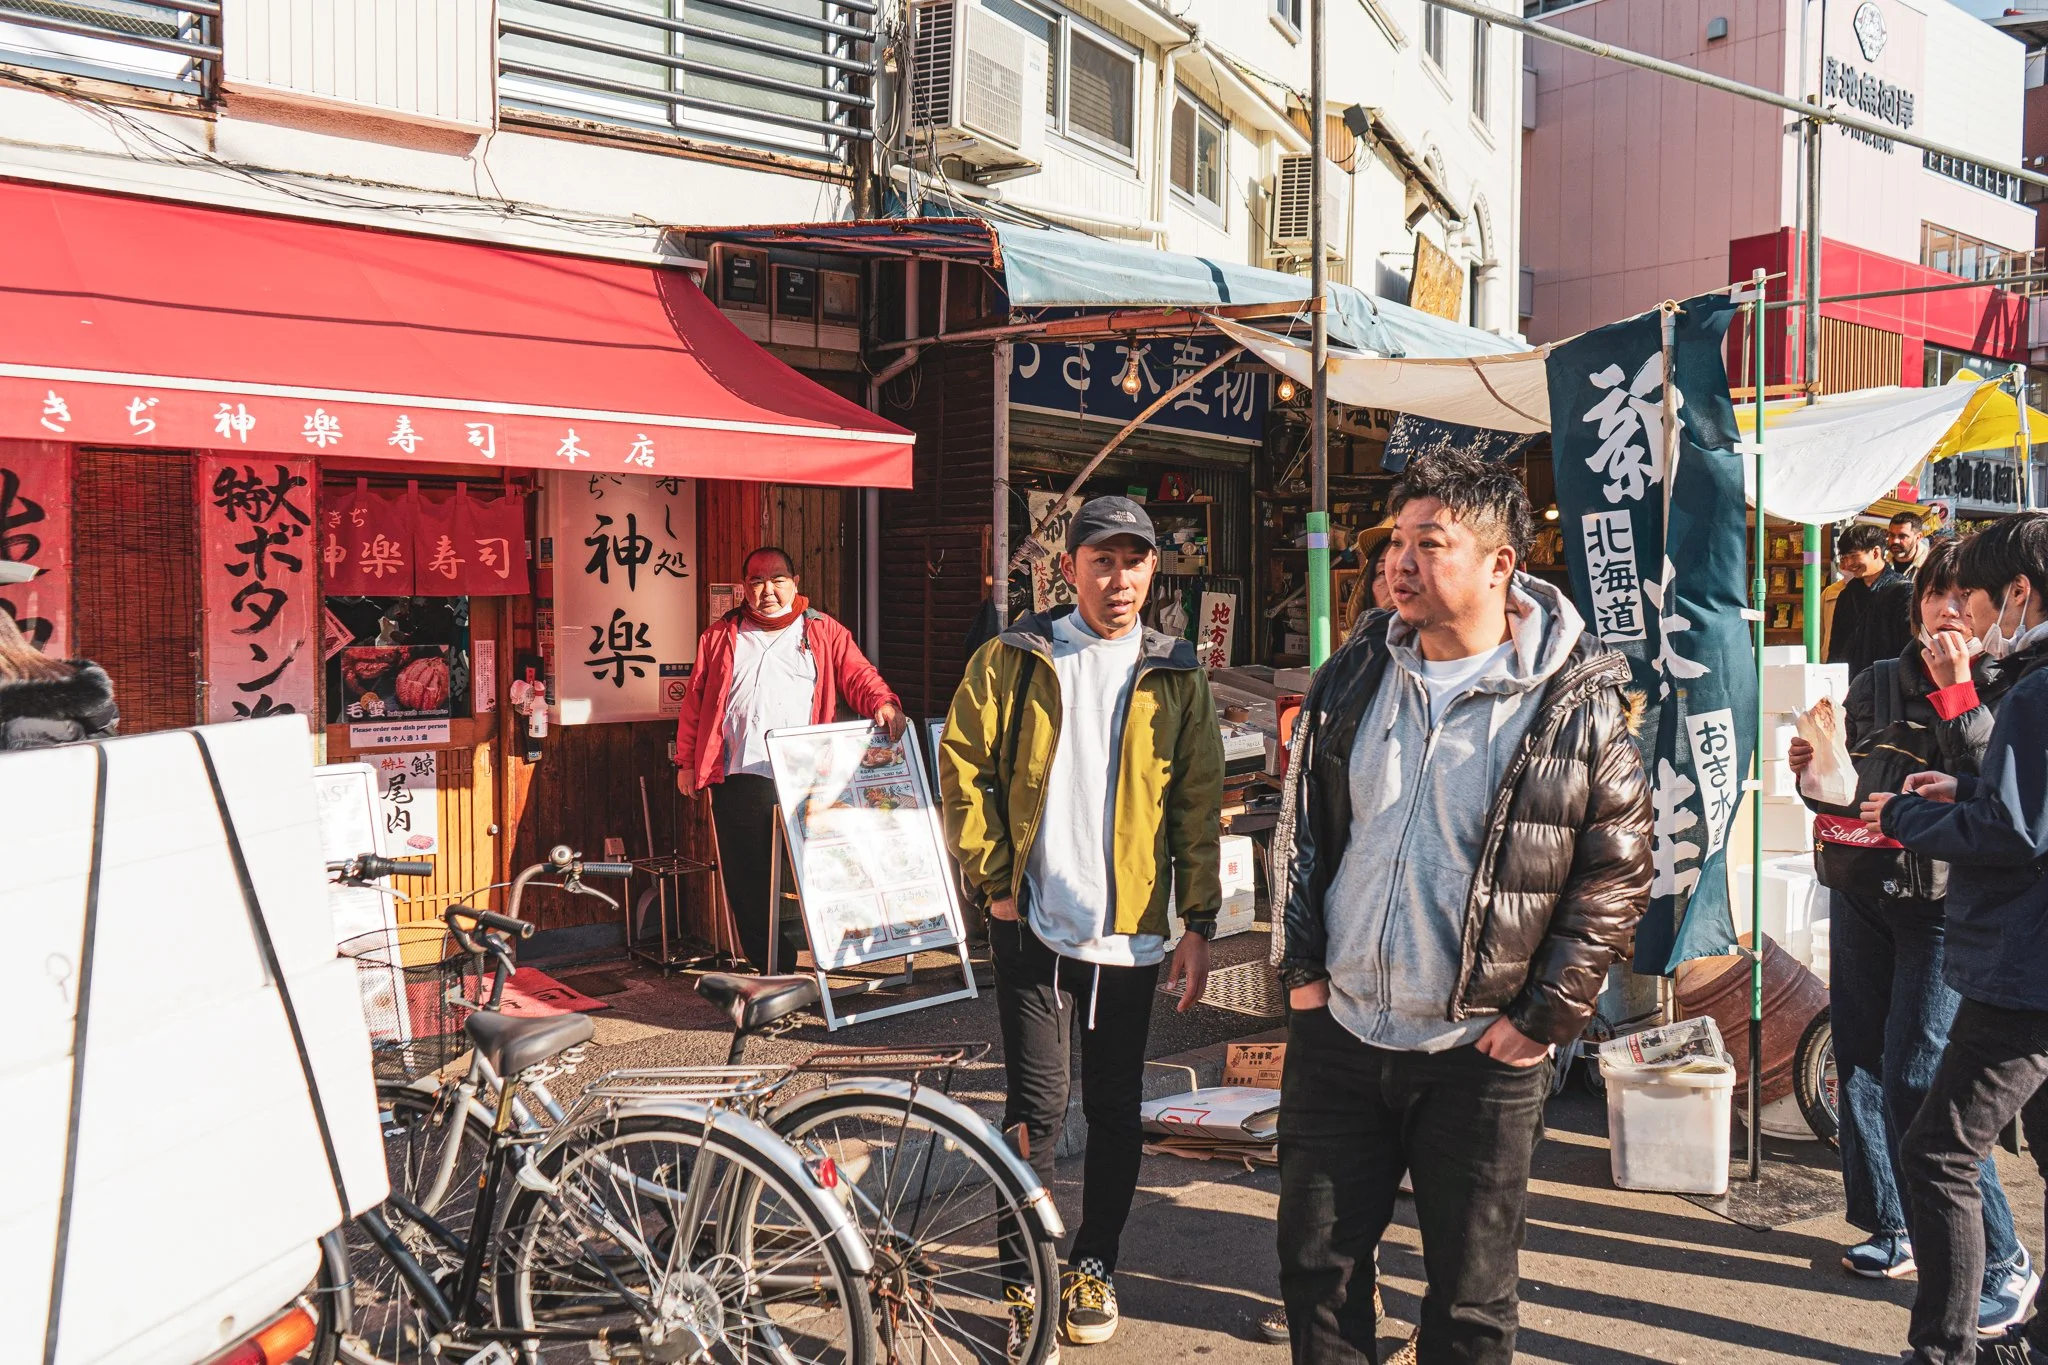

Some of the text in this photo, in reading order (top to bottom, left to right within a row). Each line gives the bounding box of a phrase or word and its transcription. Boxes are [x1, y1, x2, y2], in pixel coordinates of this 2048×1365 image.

[328, 506, 368, 529] きぢ
[1586, 517, 1644, 639] 北海道
[584, 513, 657, 689] 神楽
[346, 699, 386, 719] 毛蟹
[381, 757, 407, 771] 特上
[409, 753, 435, 777] 鯨
[381, 772, 414, 834] 尾肉
[1821, 825, 1870, 844] Stella
